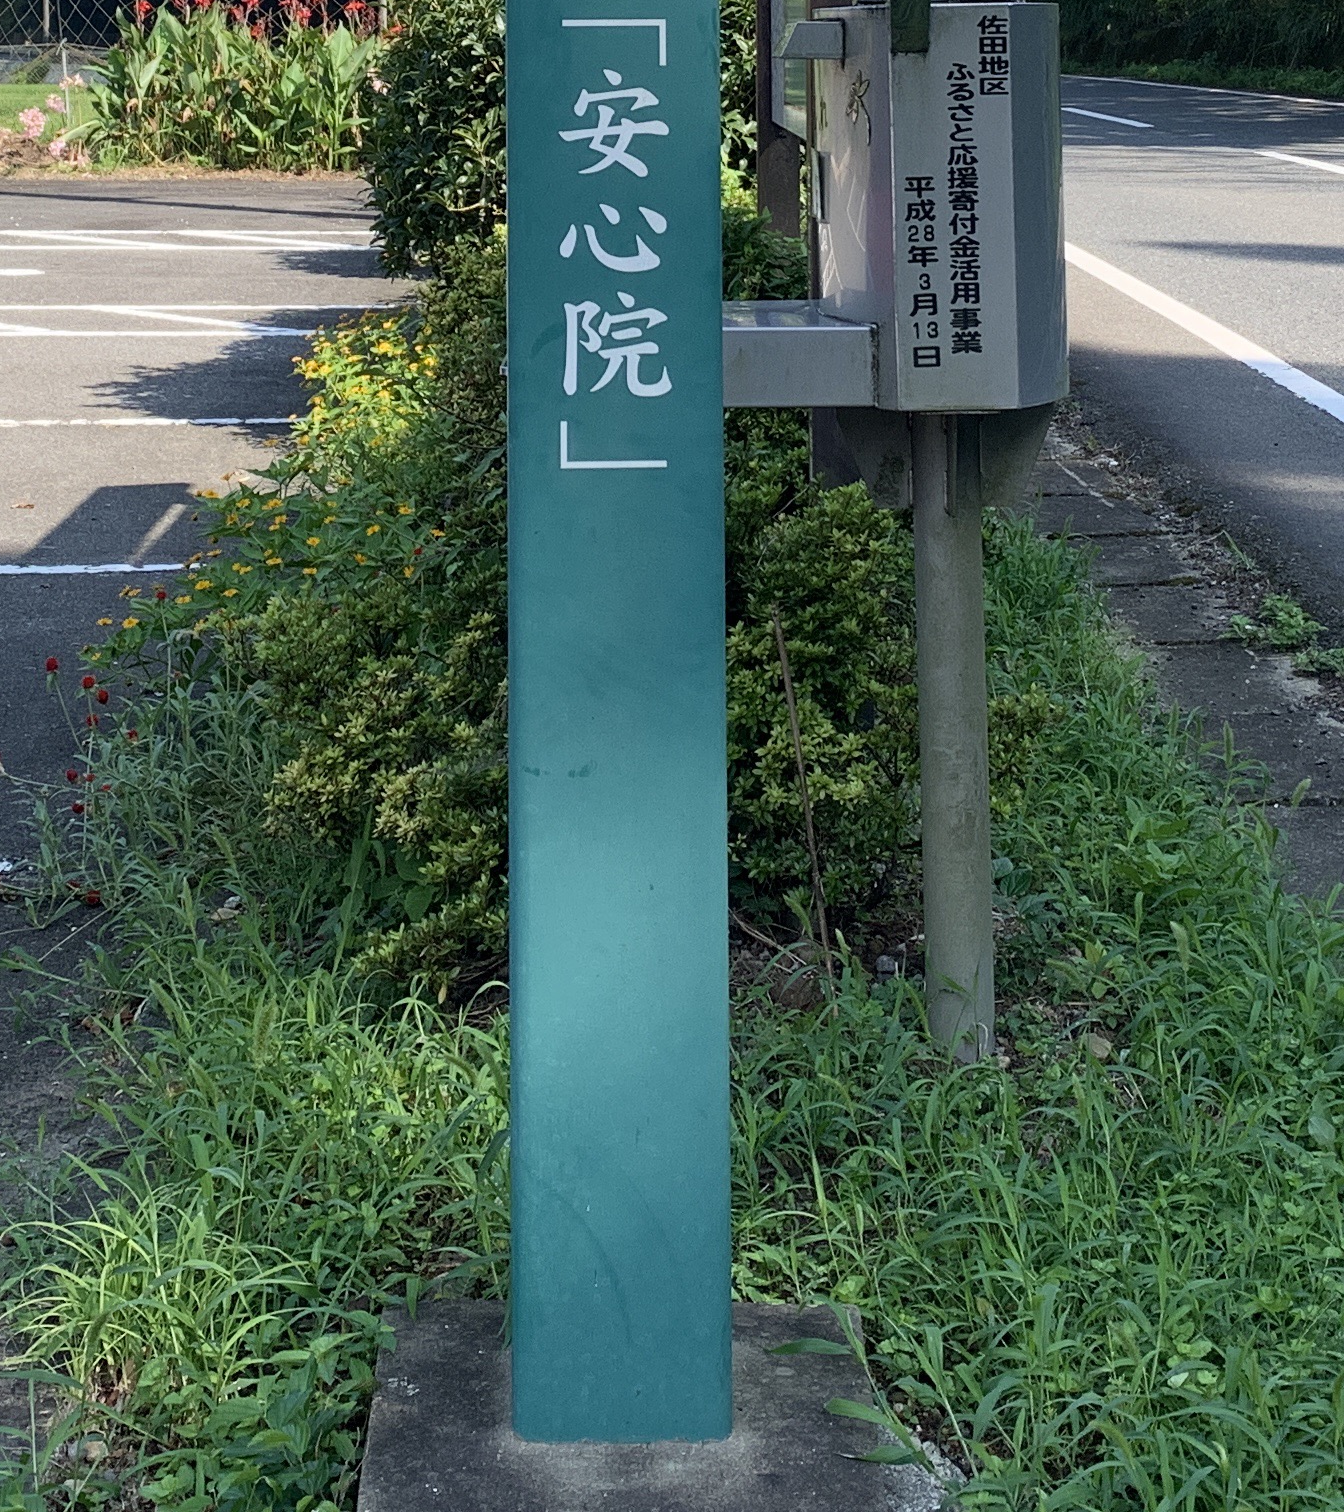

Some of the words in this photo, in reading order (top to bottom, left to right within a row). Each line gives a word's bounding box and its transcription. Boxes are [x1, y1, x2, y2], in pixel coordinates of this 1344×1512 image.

[976, 14, 1010, 96] 佐田地区
[903, 176, 942, 369] 平成28年3月13日
[945, 62, 983, 355] ふるさと応援寄付金活用事業
